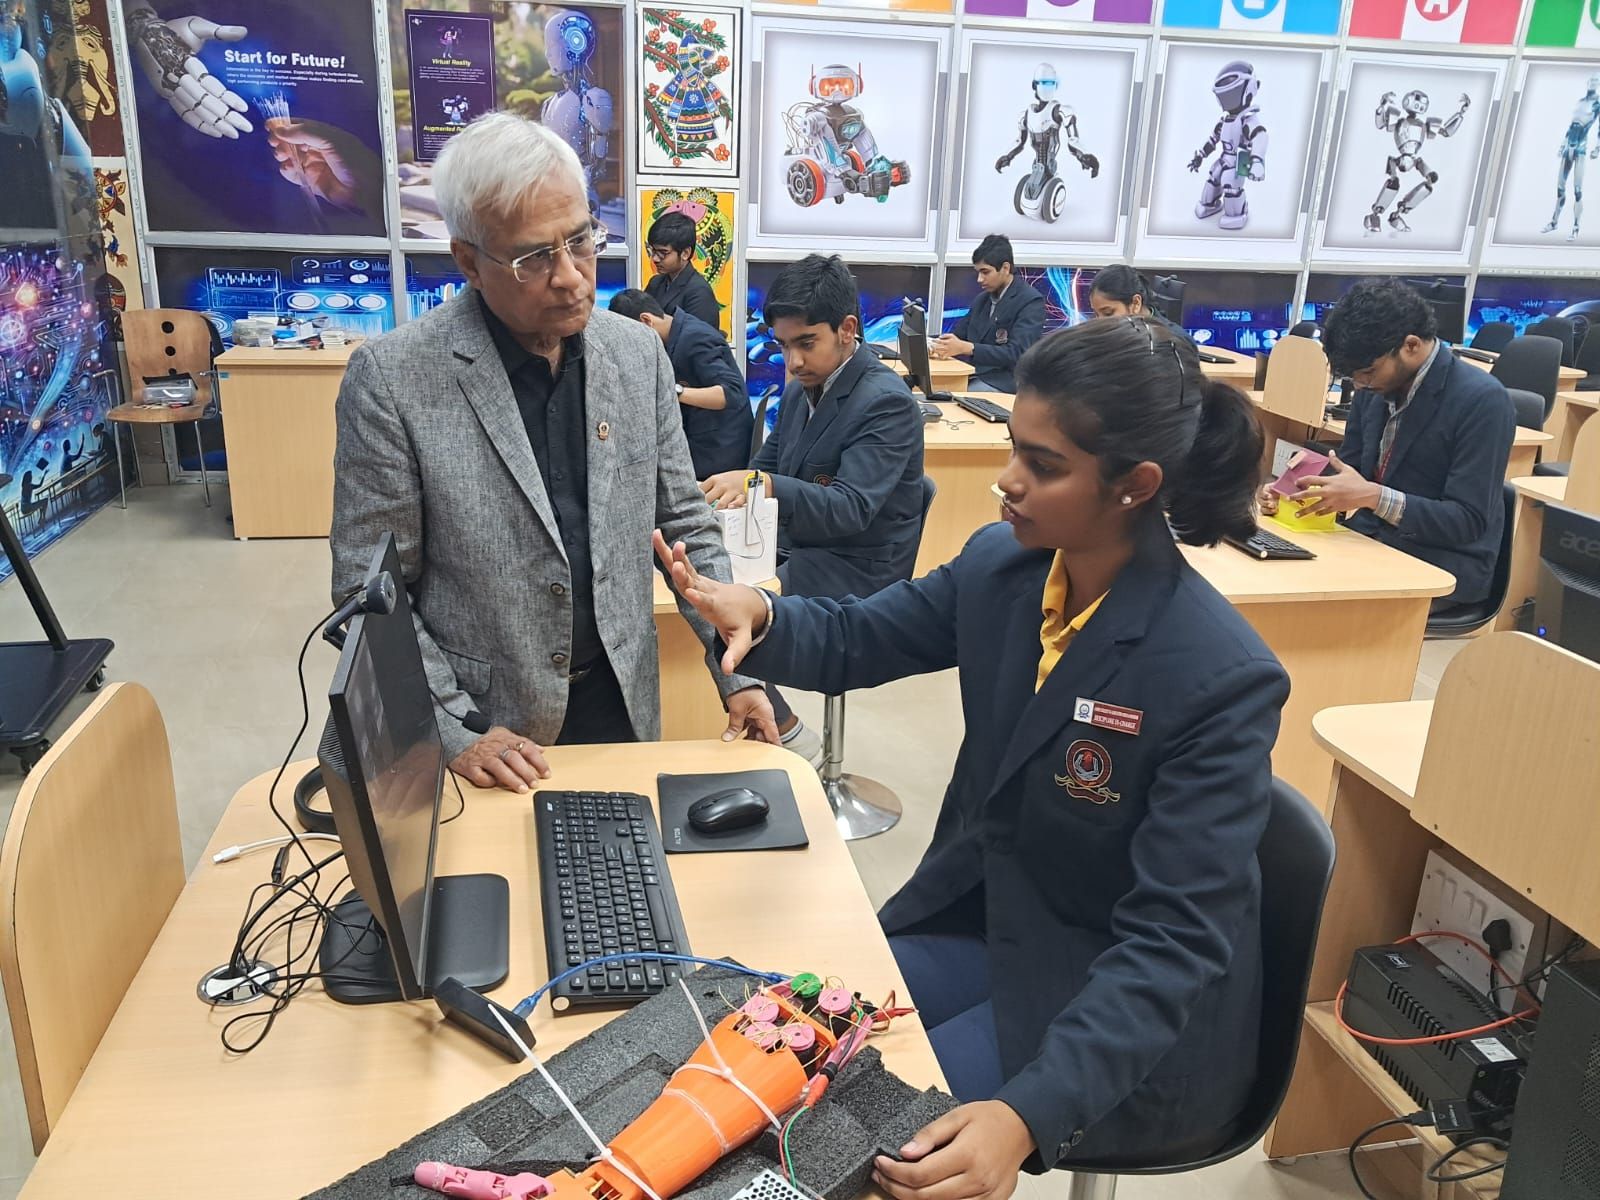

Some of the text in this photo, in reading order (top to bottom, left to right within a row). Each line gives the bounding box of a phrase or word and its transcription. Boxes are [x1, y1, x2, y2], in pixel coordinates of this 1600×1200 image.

[224, 49, 346, 68] Start for Future!
[1559, 529, 1600, 560] ace
